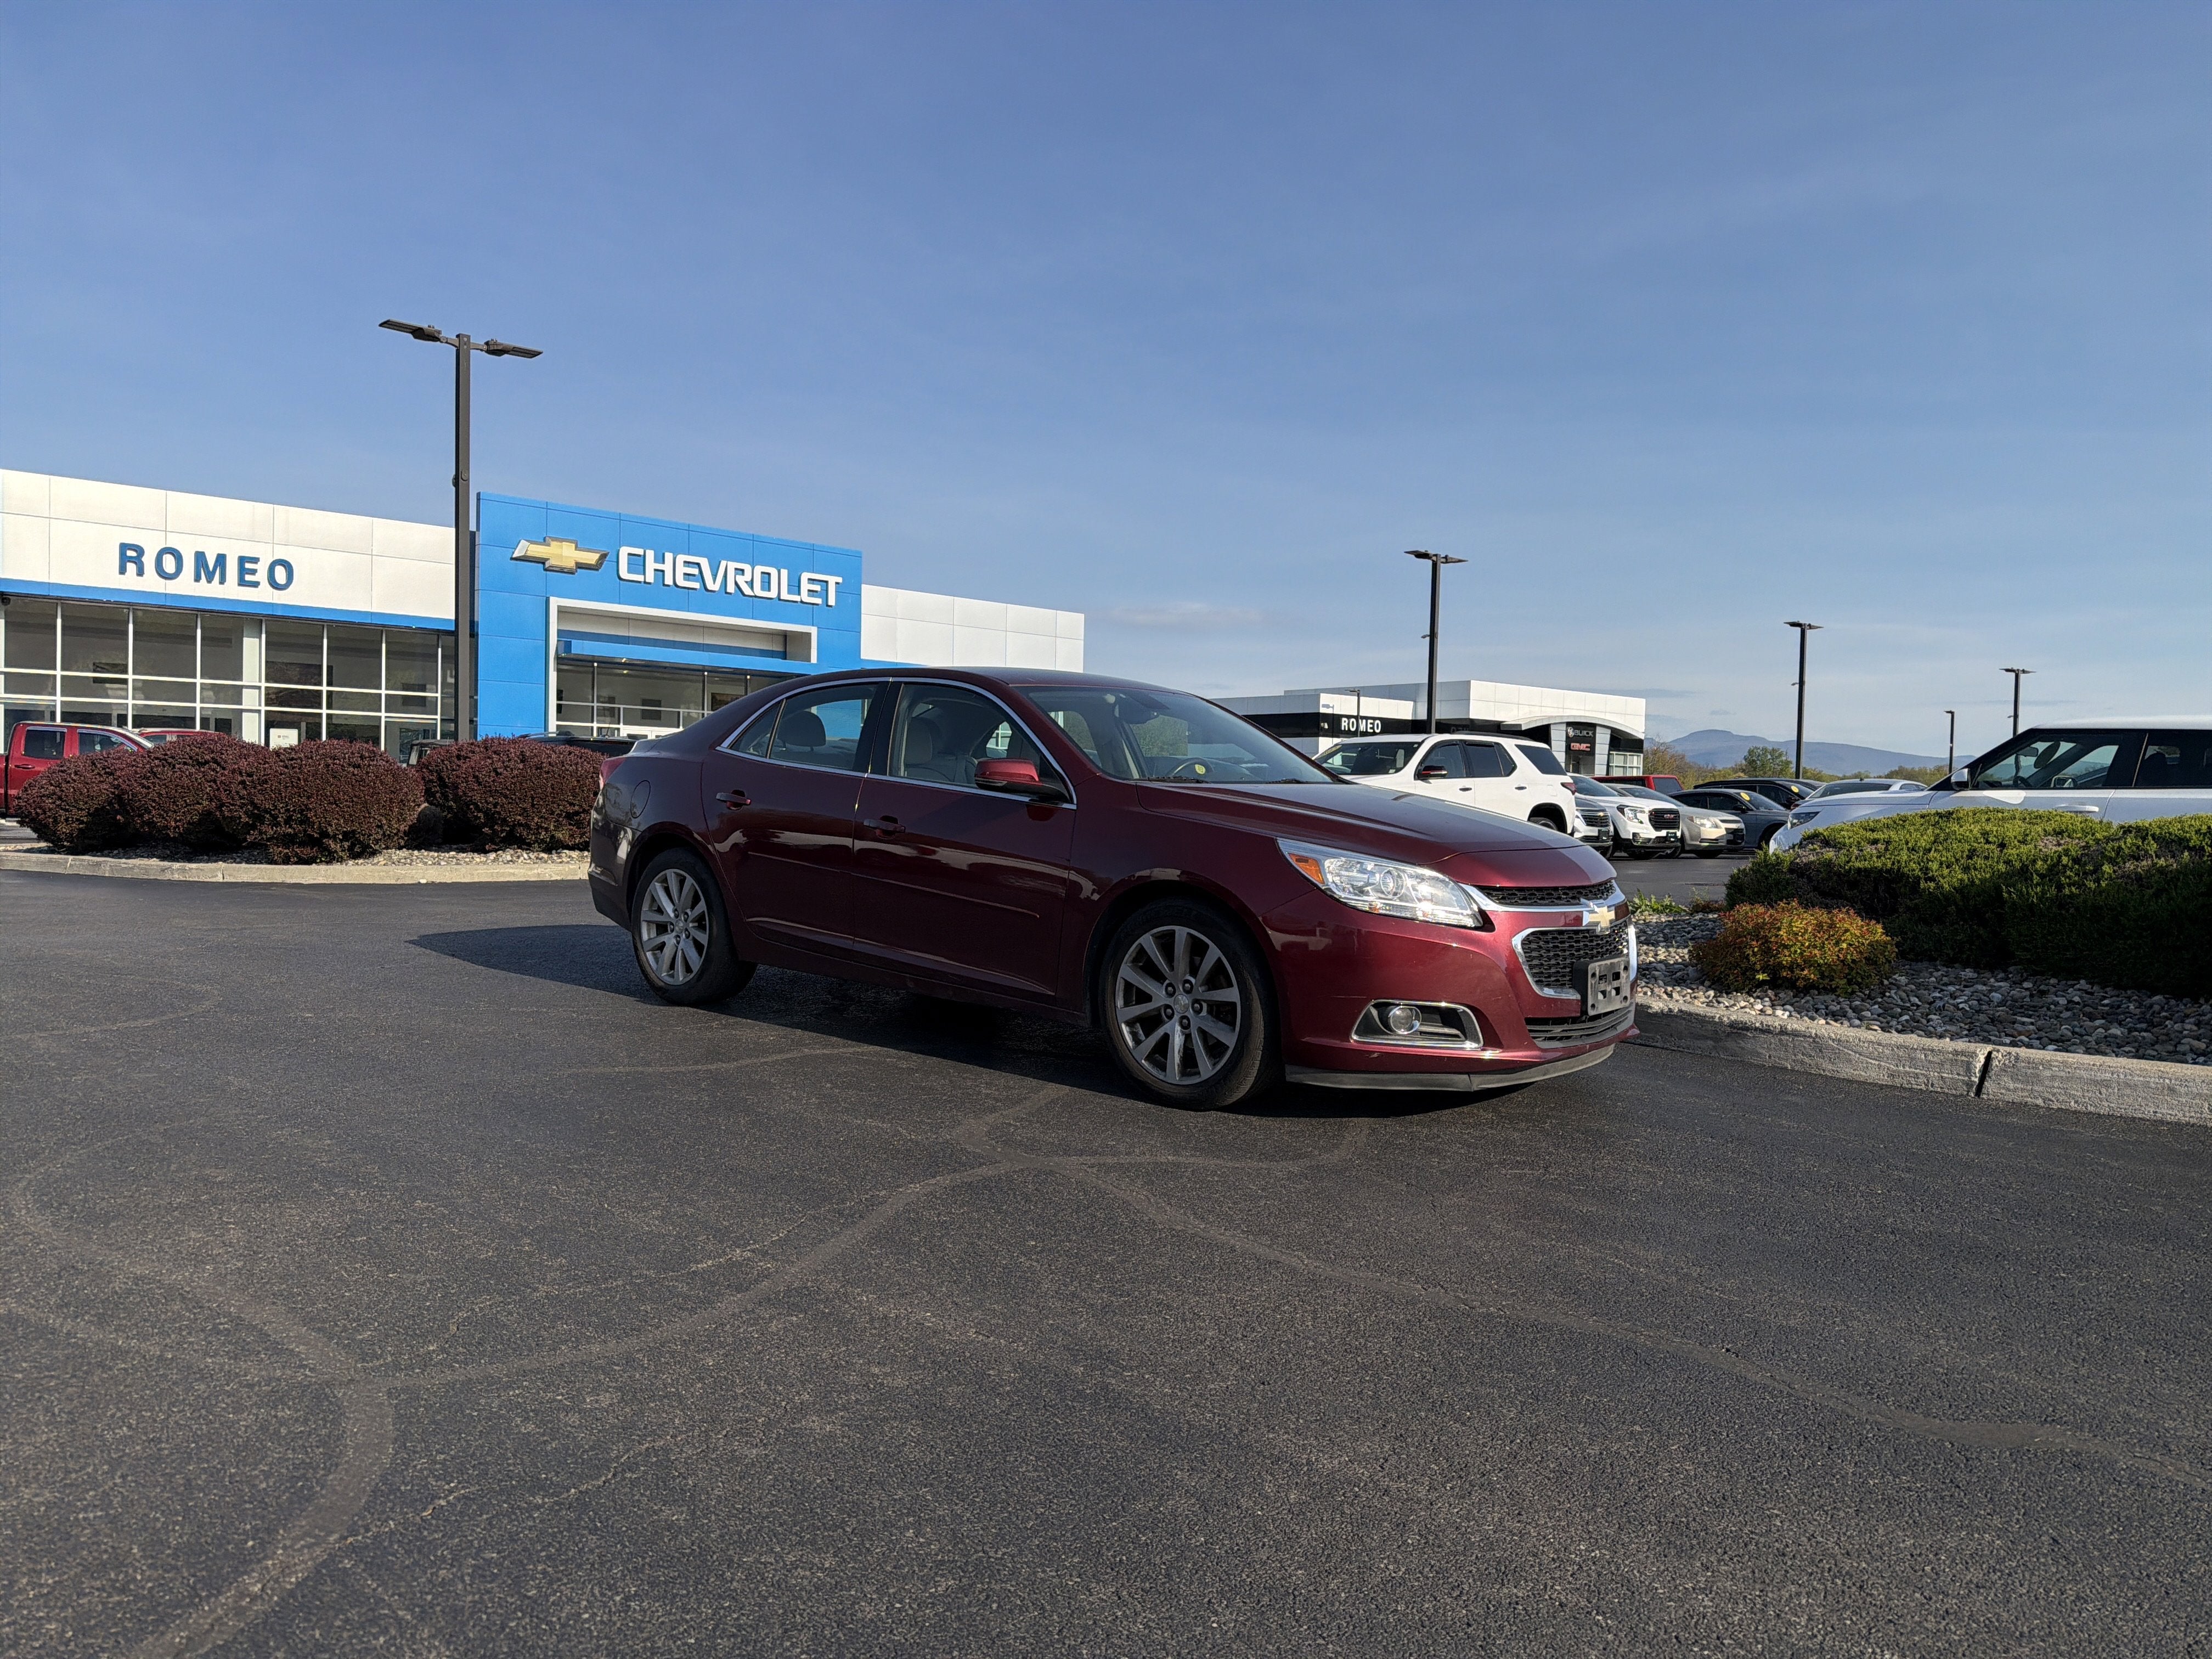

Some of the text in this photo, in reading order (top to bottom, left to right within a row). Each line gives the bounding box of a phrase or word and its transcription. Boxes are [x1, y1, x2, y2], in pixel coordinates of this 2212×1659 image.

[119, 542, 294, 591] ROMEO
[617, 546, 843, 607] CHEVROLET
[1341, 717, 1381, 732] ROMEO
[1570, 742, 1590, 751] GMC
